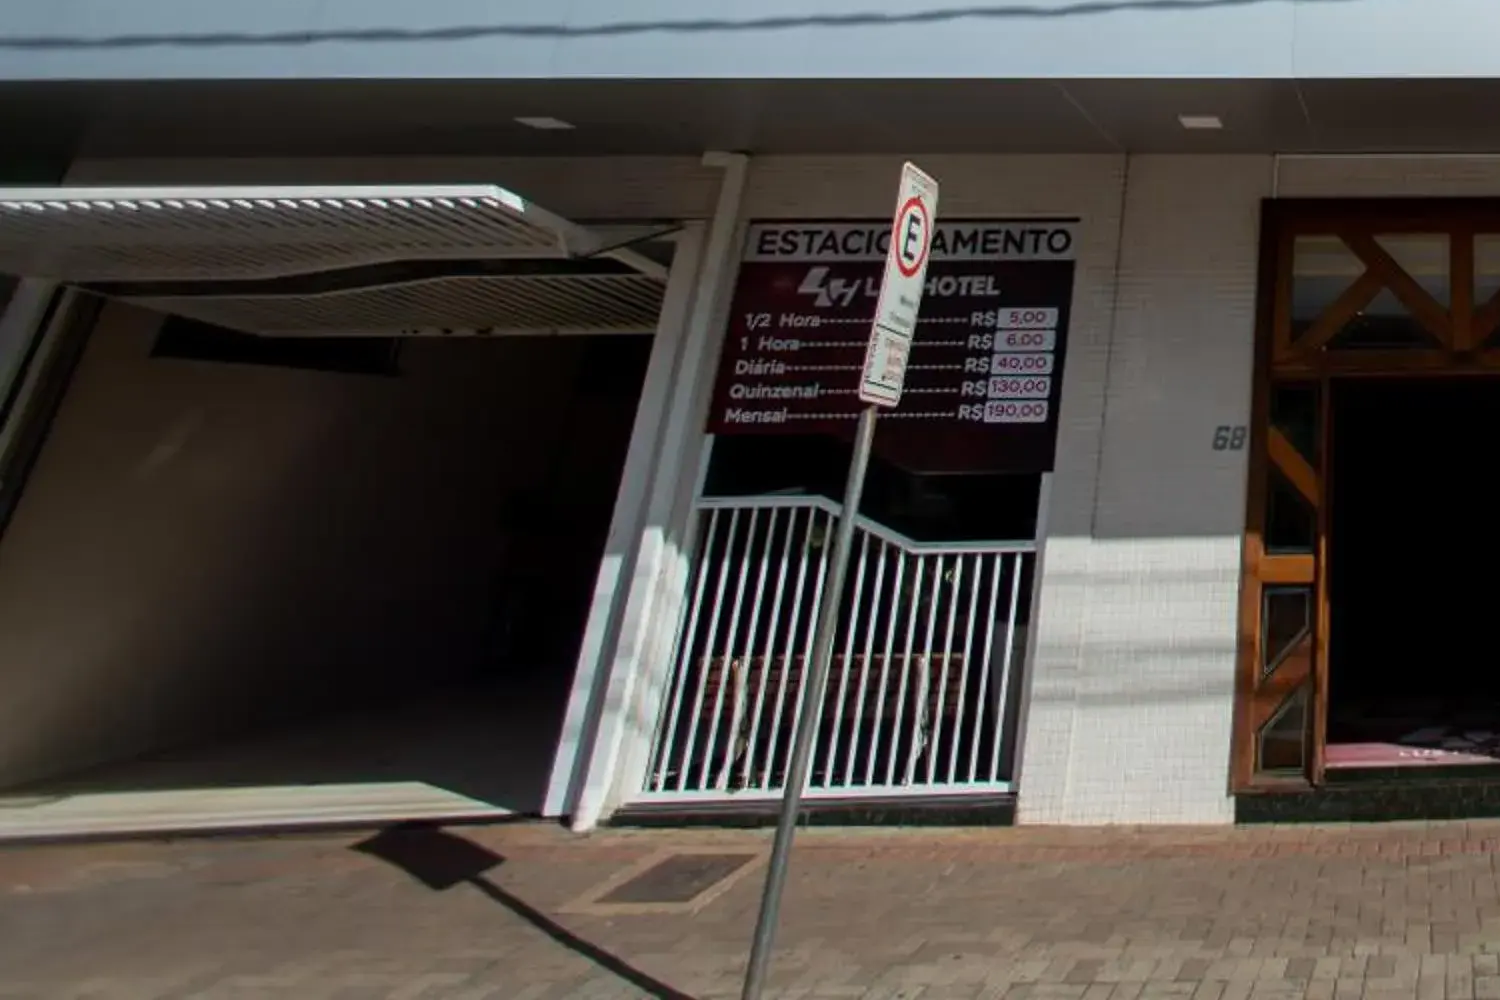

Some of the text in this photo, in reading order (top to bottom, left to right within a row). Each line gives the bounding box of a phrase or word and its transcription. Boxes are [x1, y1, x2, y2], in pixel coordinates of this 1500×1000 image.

[757, 228, 1073, 256] ESTACIOAMENTO
[903, 214, 921, 261] E
[745, 313, 772, 331] 1/2
[778, 312, 822, 328] Hora
[971, 310, 996, 328] R$
[740, 337, 749, 351] 1
[758, 336, 802, 351] Hora
[967, 333, 993, 351] R$
[735, 356, 1047, 376] Diária R$ 40,00
[729, 379, 1047, 400] Quinzenal R$ 130,00
[724, 406, 788, 424] Mensal
[958, 403, 984, 421] R$
[1212, 425, 1247, 451] 68
